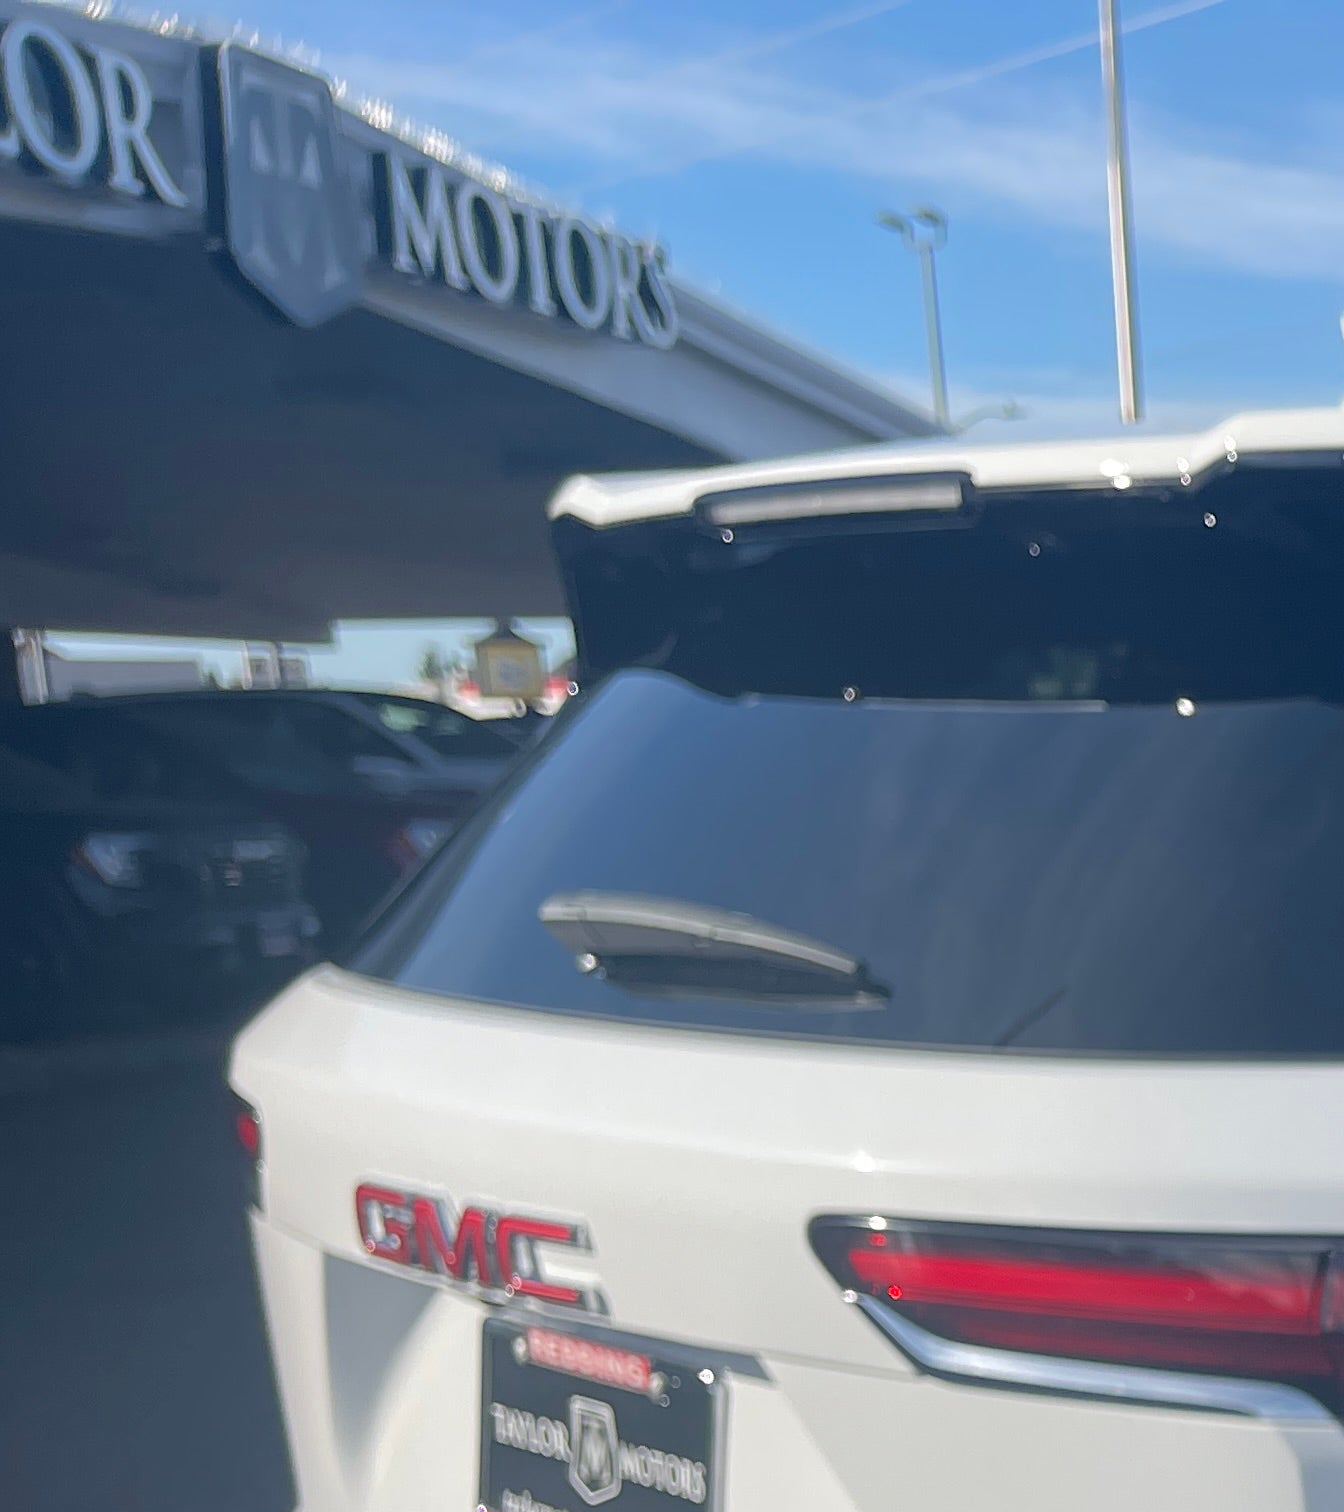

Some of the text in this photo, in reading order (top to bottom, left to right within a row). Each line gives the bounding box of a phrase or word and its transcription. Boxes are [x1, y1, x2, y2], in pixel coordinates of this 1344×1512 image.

[0, 19, 189, 208] OR
[388, 151, 681, 350] MOTORS
[353, 1180, 605, 1314] GMC
[529, 1332, 649, 1388] REDDING
[492, 1402, 574, 1463] TAYLOR
[618, 1440, 707, 1504] MOTORS
